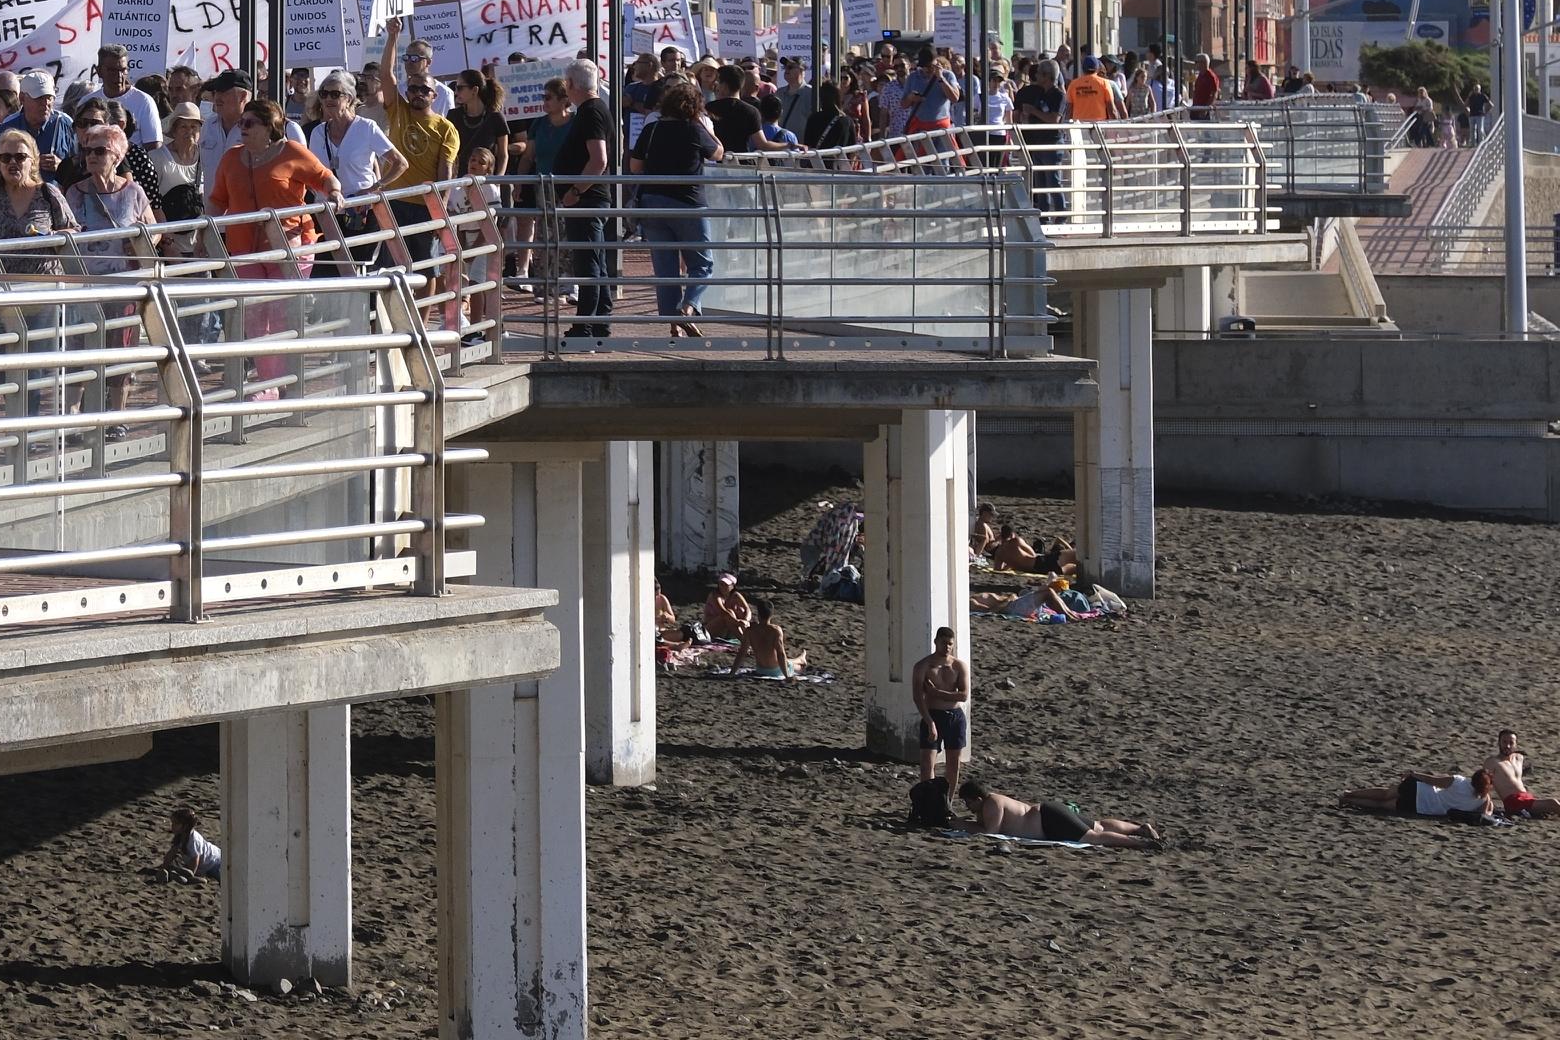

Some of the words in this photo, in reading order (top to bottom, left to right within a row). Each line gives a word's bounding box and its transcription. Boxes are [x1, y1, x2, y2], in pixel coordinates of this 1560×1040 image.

[108, 9, 161, 22] ATLÁNTICO
[290, 11, 327, 22] UNIDOS
[114, 27, 153, 39] UNIDOS
[316, 24, 336, 34] MÁS
[423, 23, 450, 32] UNIDOS
[419, 33, 443, 42] OMOS
[443, 31, 459, 40] MÁS
[140, 41, 160, 53] MÁS
[294, 41, 321, 51] LPGC
[1310, 39, 1344, 59] IDAS
[127, 59, 143, 69] GC
